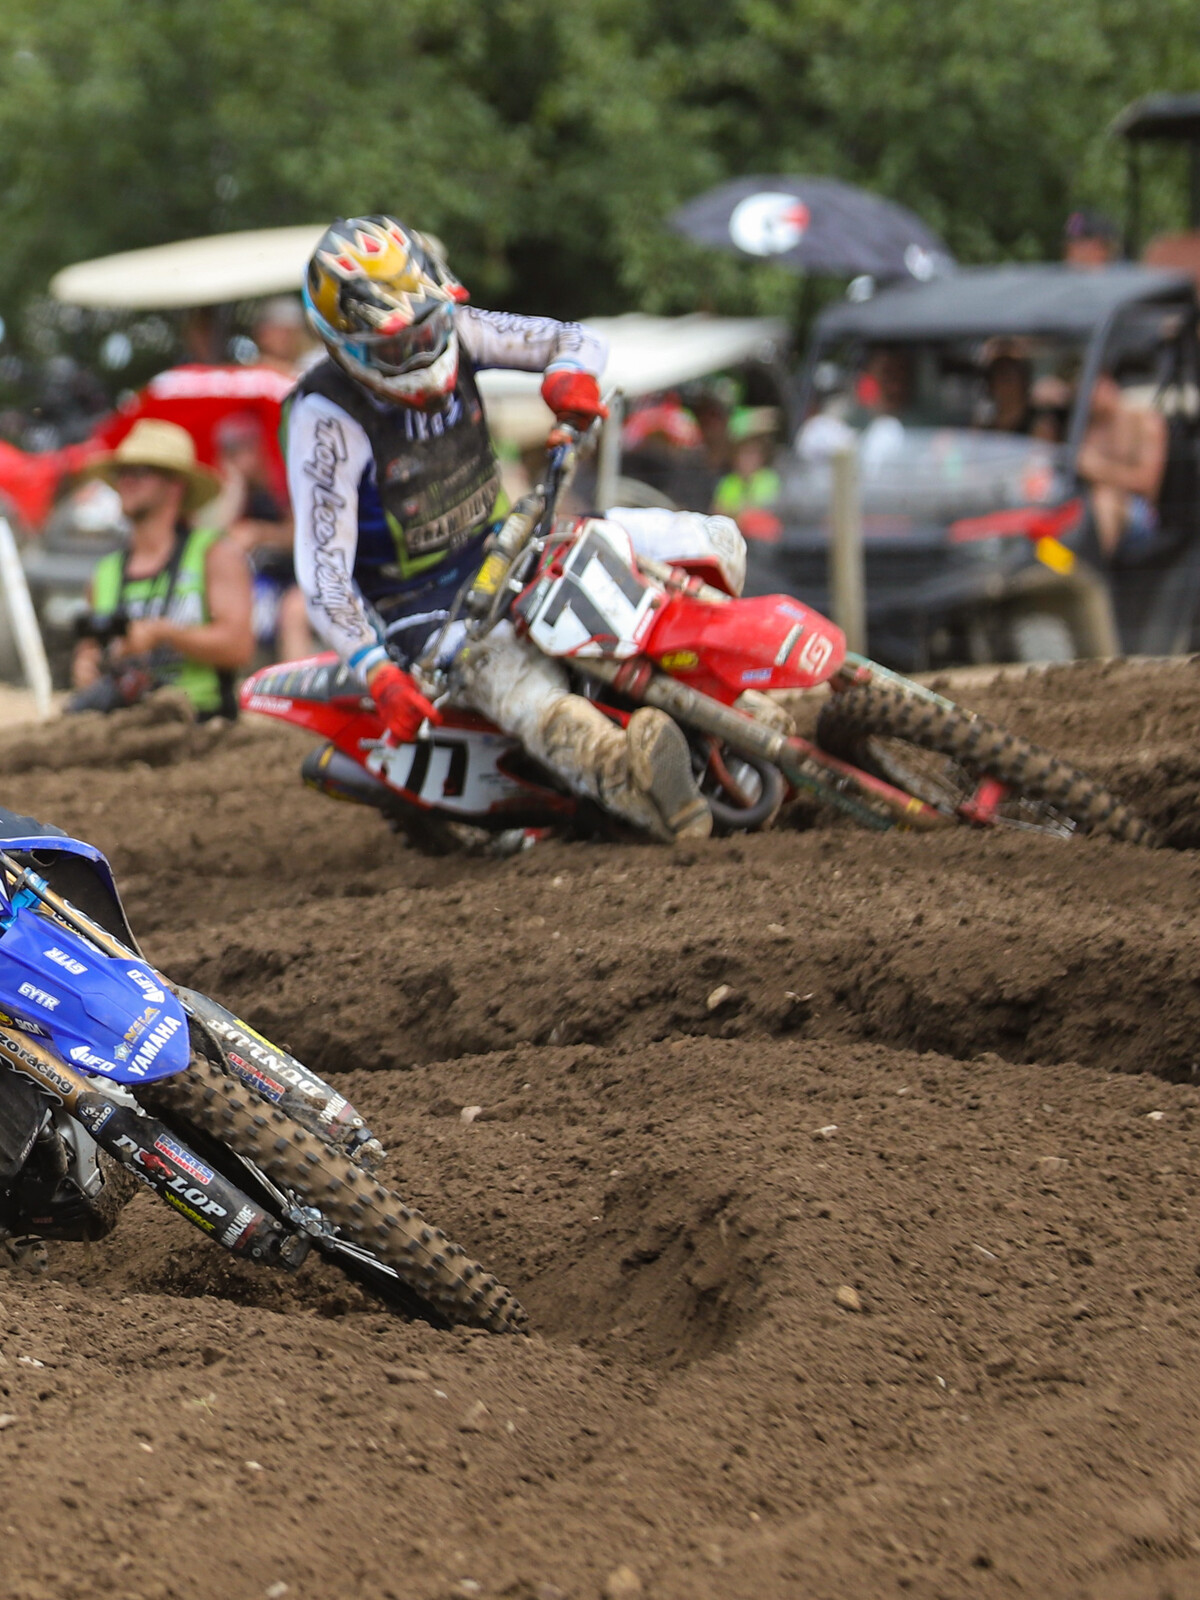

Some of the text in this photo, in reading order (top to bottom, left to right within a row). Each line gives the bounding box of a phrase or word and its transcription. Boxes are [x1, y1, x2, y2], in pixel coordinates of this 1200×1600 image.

[304, 417, 347, 486] Troy
[312, 485, 345, 546] Lee
[43, 947, 88, 975] GYTR
[127, 969, 159, 997] UFO
[17, 981, 60, 1011] GYTR
[79, 1053, 117, 1073] UFO
[128, 1016, 182, 1076] YAMAHA
[207, 1019, 325, 1097] DUNLOP
[19, 1049, 74, 1095] racing
[91, 1105, 113, 1132] enzo
[155, 1141, 210, 1185] UNLIMITED
[157, 1134, 215, 1180] PARTS
